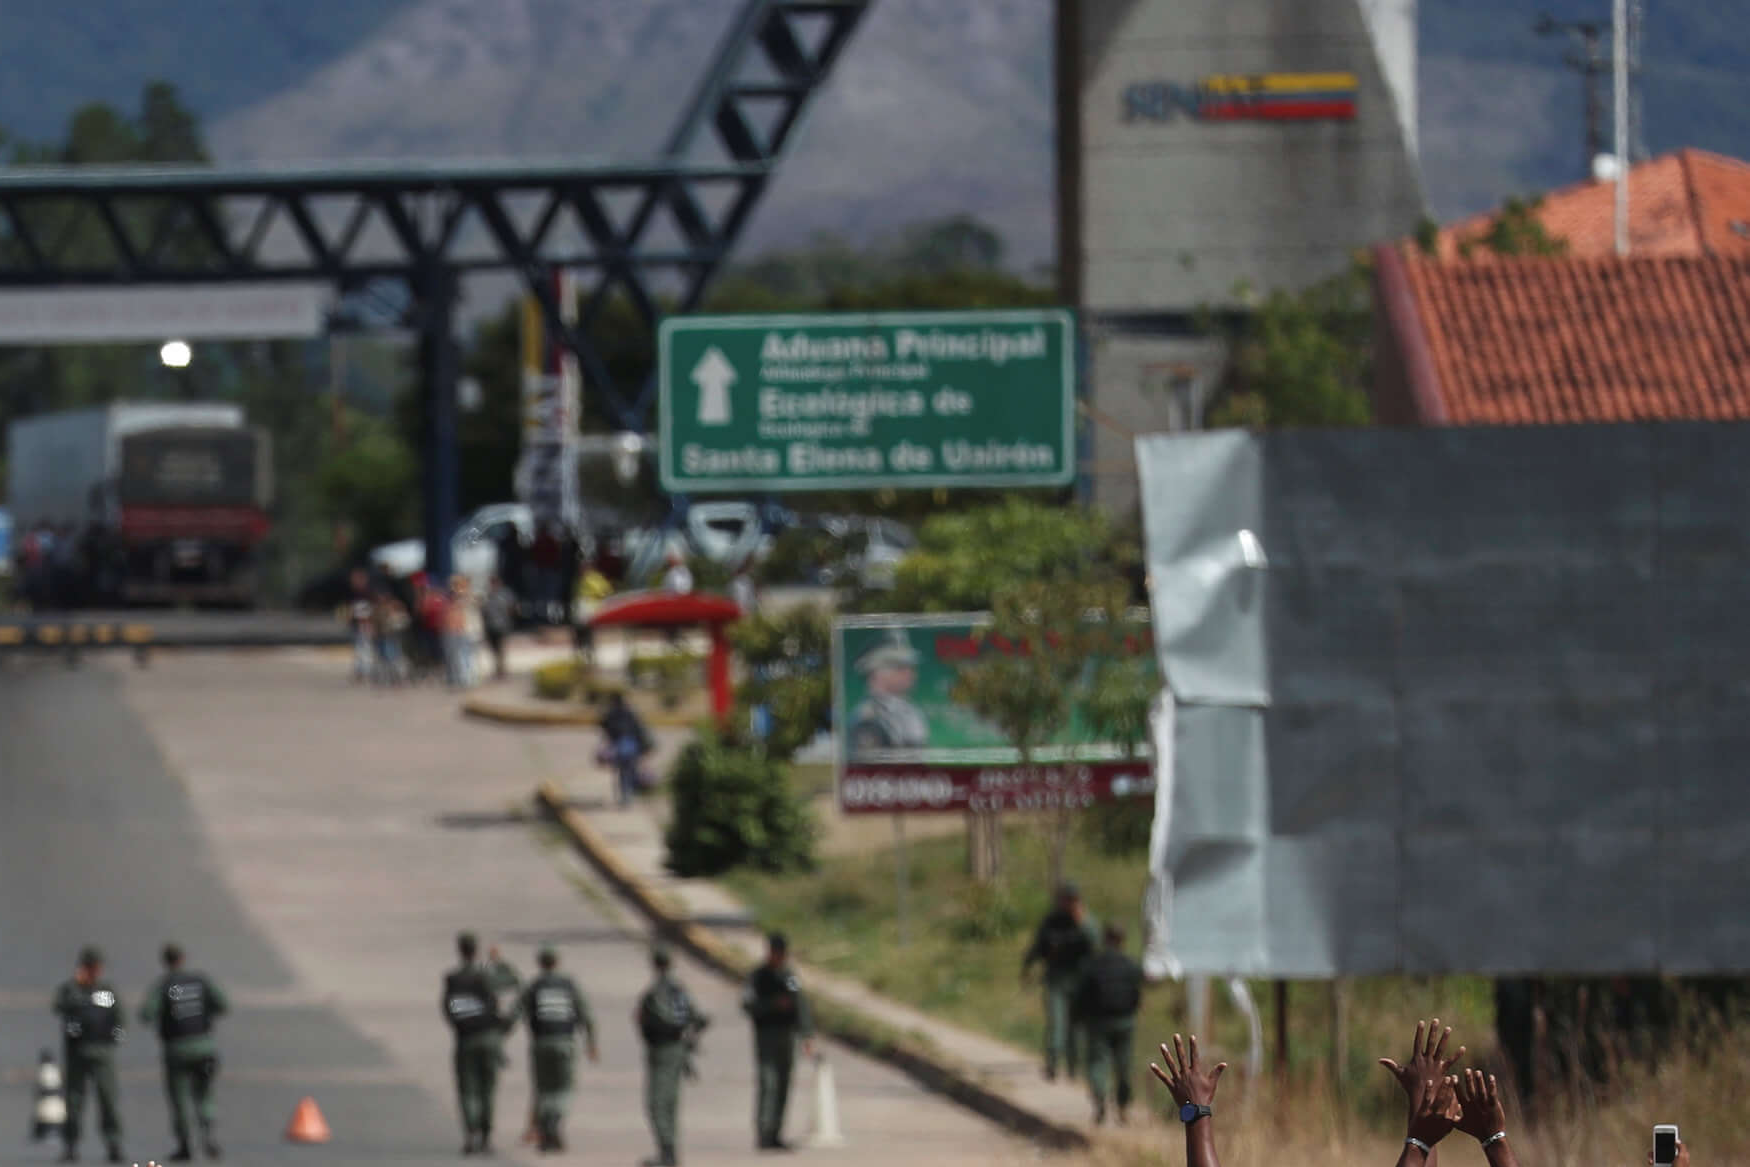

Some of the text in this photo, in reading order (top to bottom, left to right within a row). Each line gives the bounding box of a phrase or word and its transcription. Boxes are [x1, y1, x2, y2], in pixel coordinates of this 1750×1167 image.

[761, 327, 1047, 366] Aduana Principal
[932, 385, 973, 416] de
[681, 443, 781, 475] Santa
[787, 440, 884, 474] Elena
[890, 441, 933, 472] de
